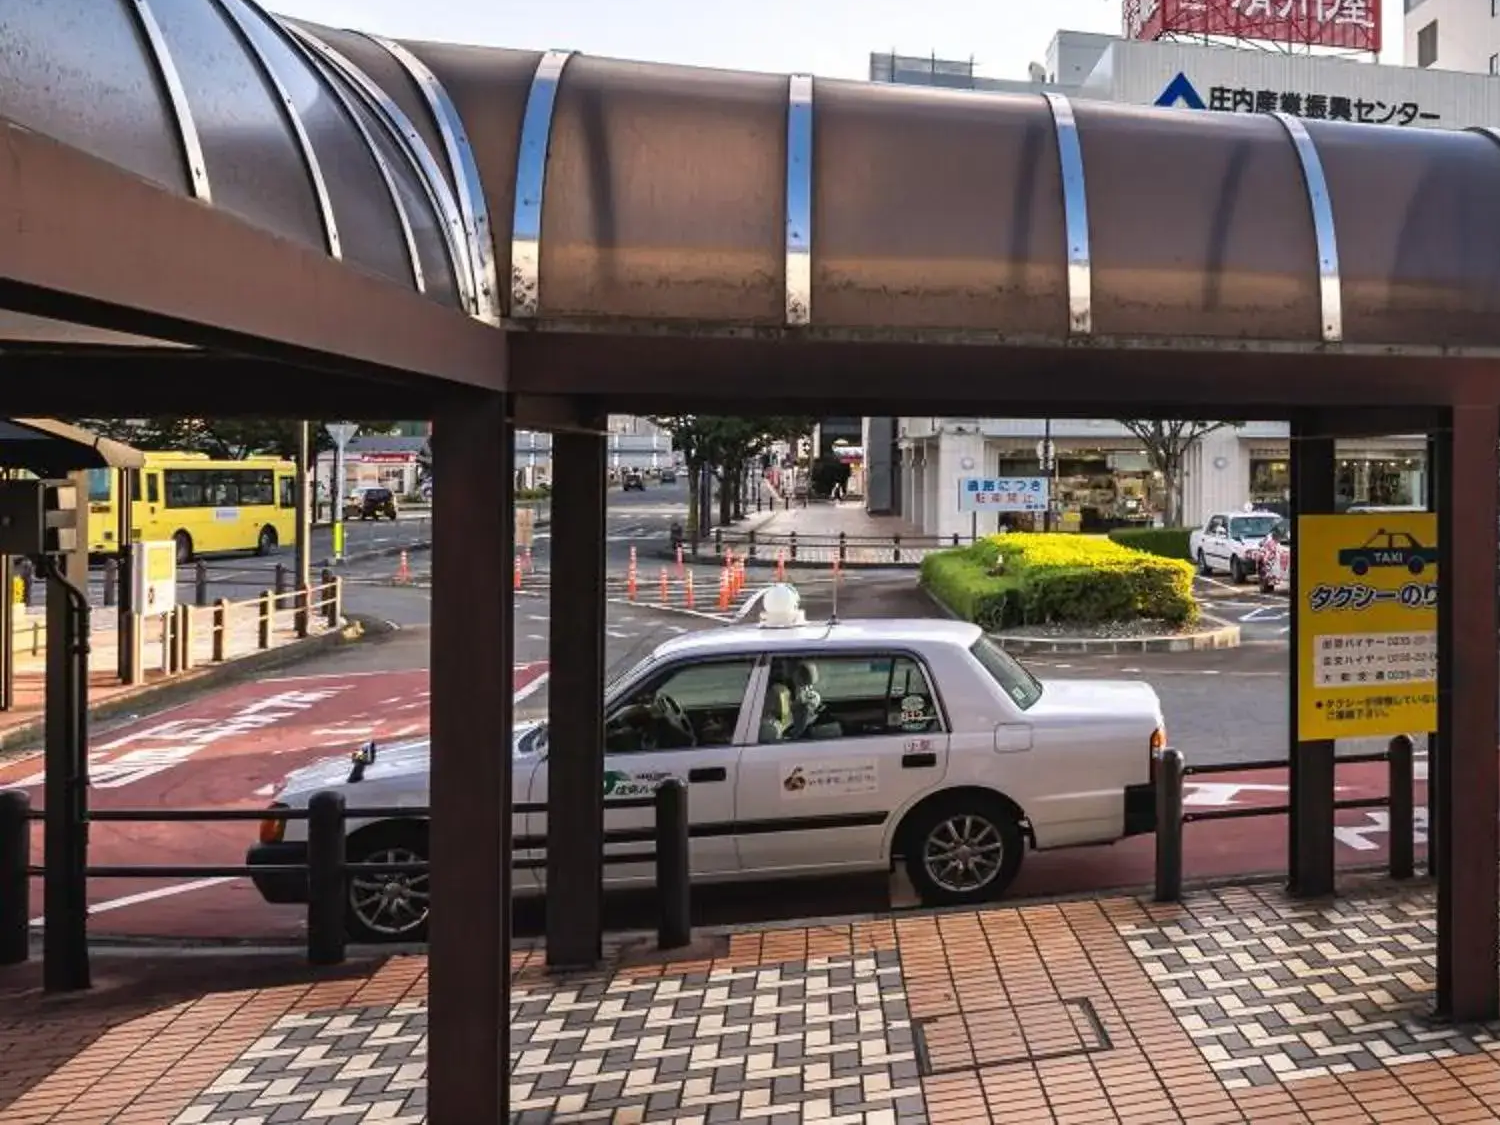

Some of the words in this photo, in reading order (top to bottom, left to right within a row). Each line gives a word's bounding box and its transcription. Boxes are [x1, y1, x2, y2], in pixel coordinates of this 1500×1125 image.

[1208, 85, 1441, 125] 庄内産業振興センター
[1373, 552, 1404, 563] TAXI
[1310, 582, 1438, 611] タクシーのり
